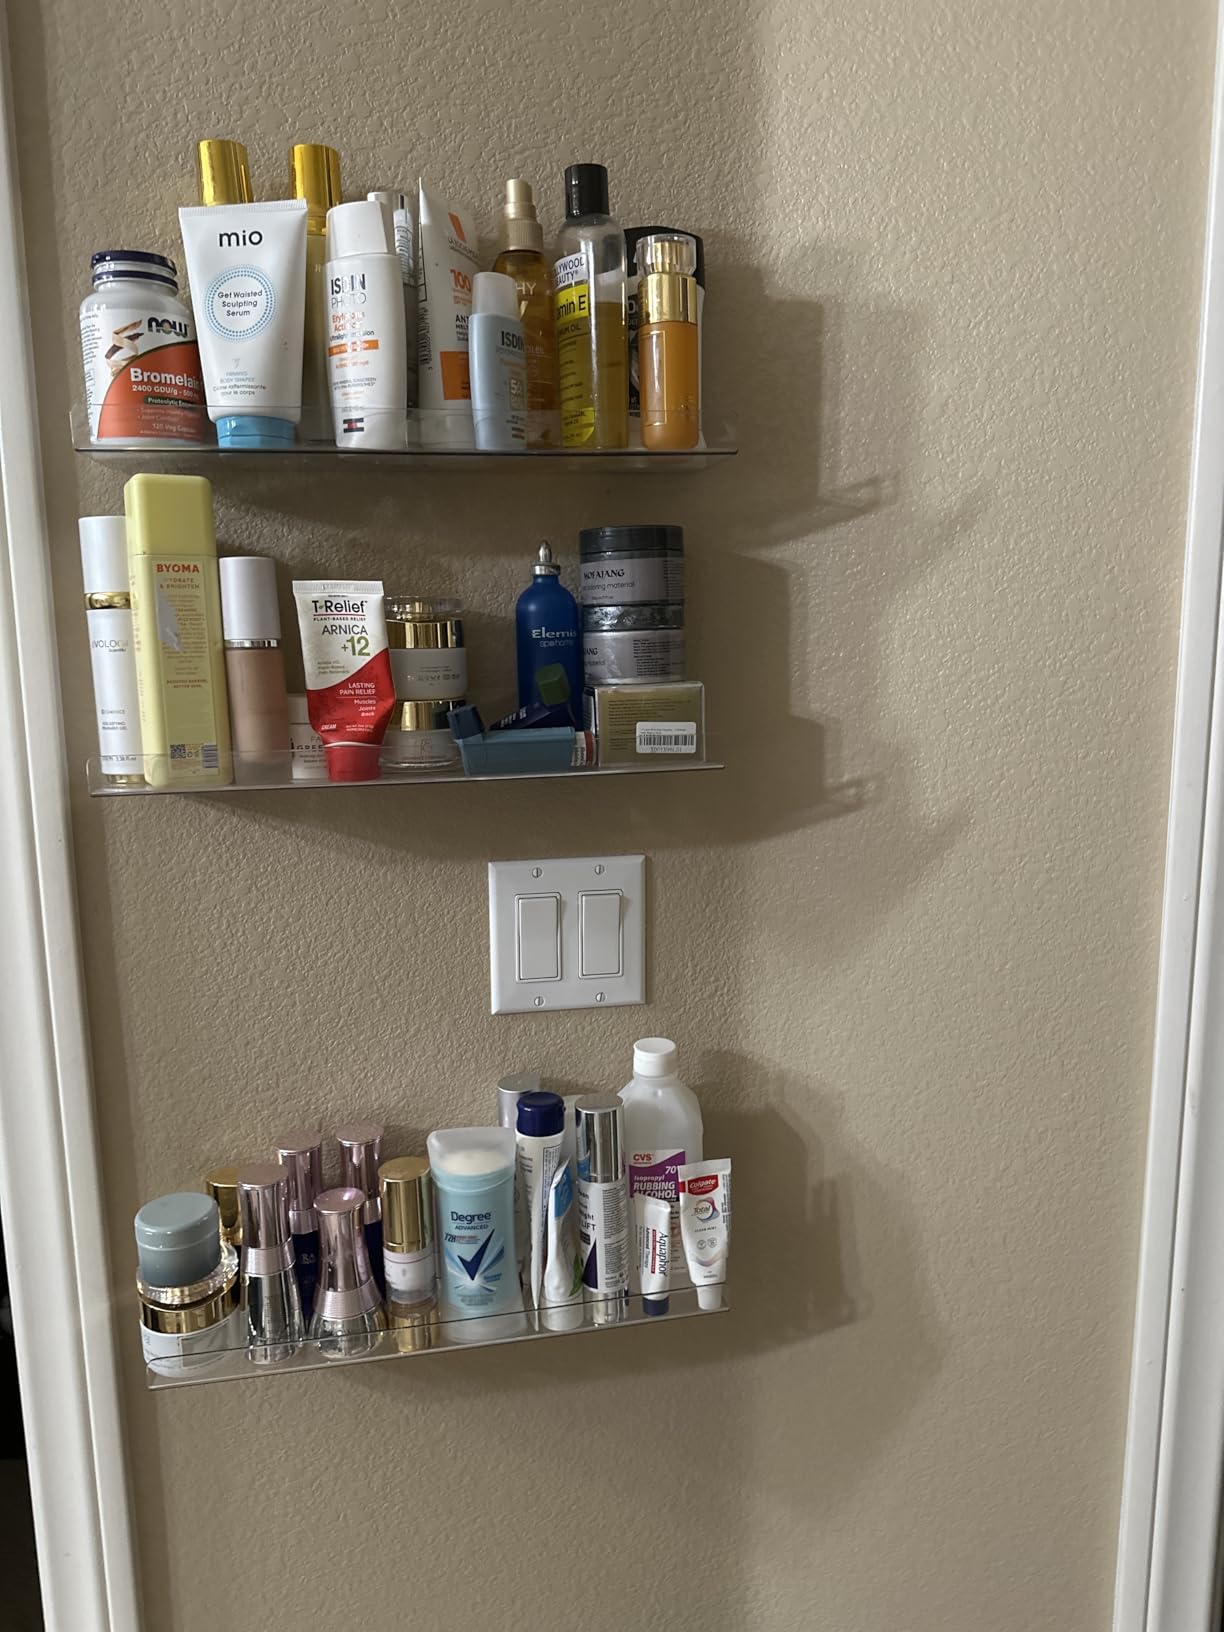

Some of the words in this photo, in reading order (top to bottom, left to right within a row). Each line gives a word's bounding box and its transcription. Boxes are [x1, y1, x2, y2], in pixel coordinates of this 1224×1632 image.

[219, 230, 263, 247] mio
[233, 290, 263, 299] Waisted
[222, 300, 258, 308] Sculpting
[331, 292, 367, 309] PHTO
[579, 294, 587, 311] E
[156, 563, 200, 573] BYOMA
[322, 624, 369, 635] ARNICA
[531, 626, 577, 639] Elemis
[341, 635, 371, 656] +12
[633, 1153, 652, 1161] CVS
[665, 1165, 677, 1174] 70
[634, 1174, 665, 1182] Isopropyl
[689, 1178, 716, 1189] Colgate
[633, 1181, 676, 1191] RUBBING
[636, 1190, 678, 1199] LCOHOL
[451, 1211, 492, 1225] Degree
[656, 1231, 670, 1277] Aquaphor
